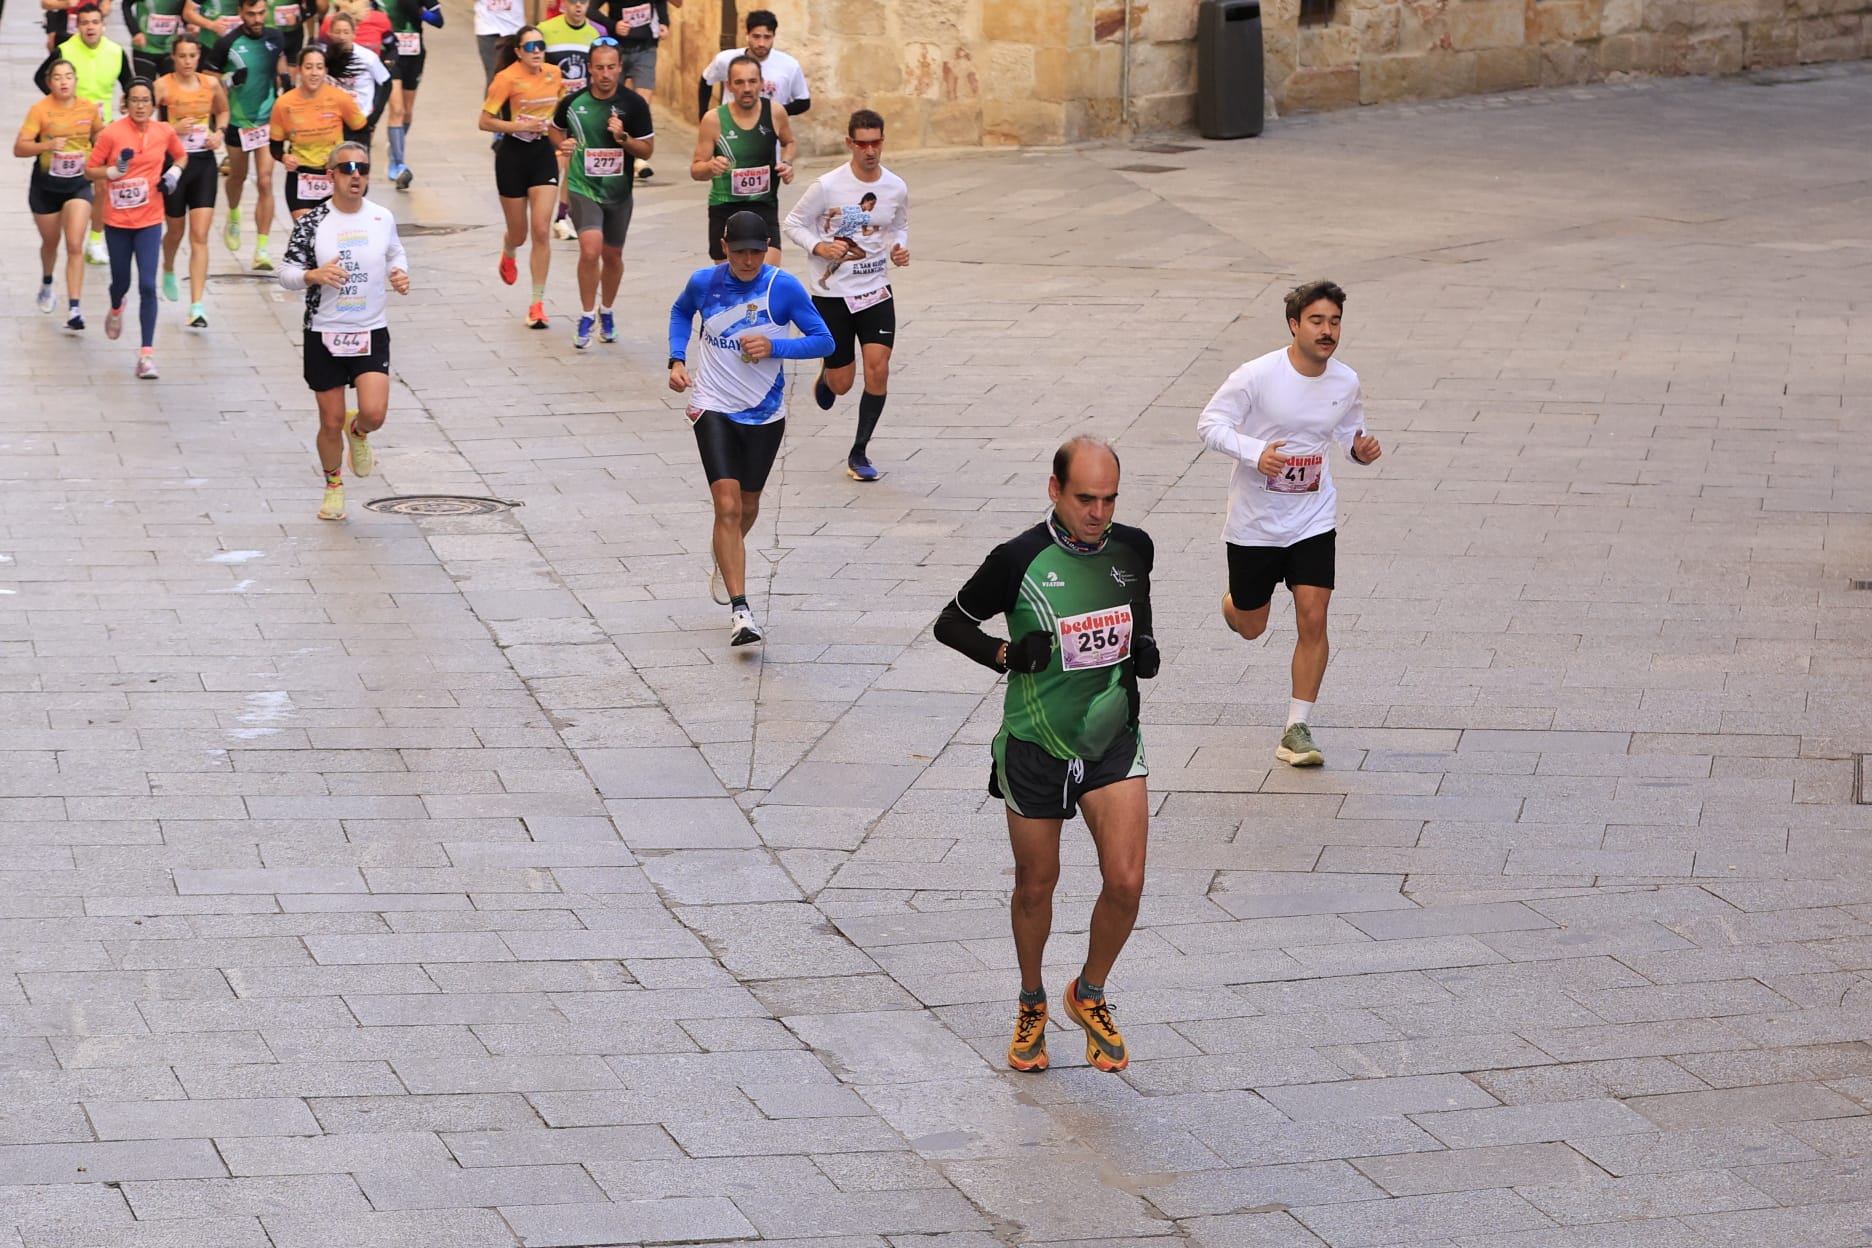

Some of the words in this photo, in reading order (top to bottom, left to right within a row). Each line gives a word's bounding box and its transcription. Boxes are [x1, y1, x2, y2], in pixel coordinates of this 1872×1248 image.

[594, 158, 616, 168] 277
[307, 181, 328, 191] 160
[741, 177, 763, 188] 601
[119, 190, 141, 200] 420
[339, 250, 352, 261] 32
[339, 286, 357, 296] AVS
[333, 335, 360, 347] 644
[1286, 456, 1322, 467] dunia
[1285, 467, 1306, 481] 41
[1061, 611, 1131, 635] bedunia
[1078, 627, 1119, 653] 256
